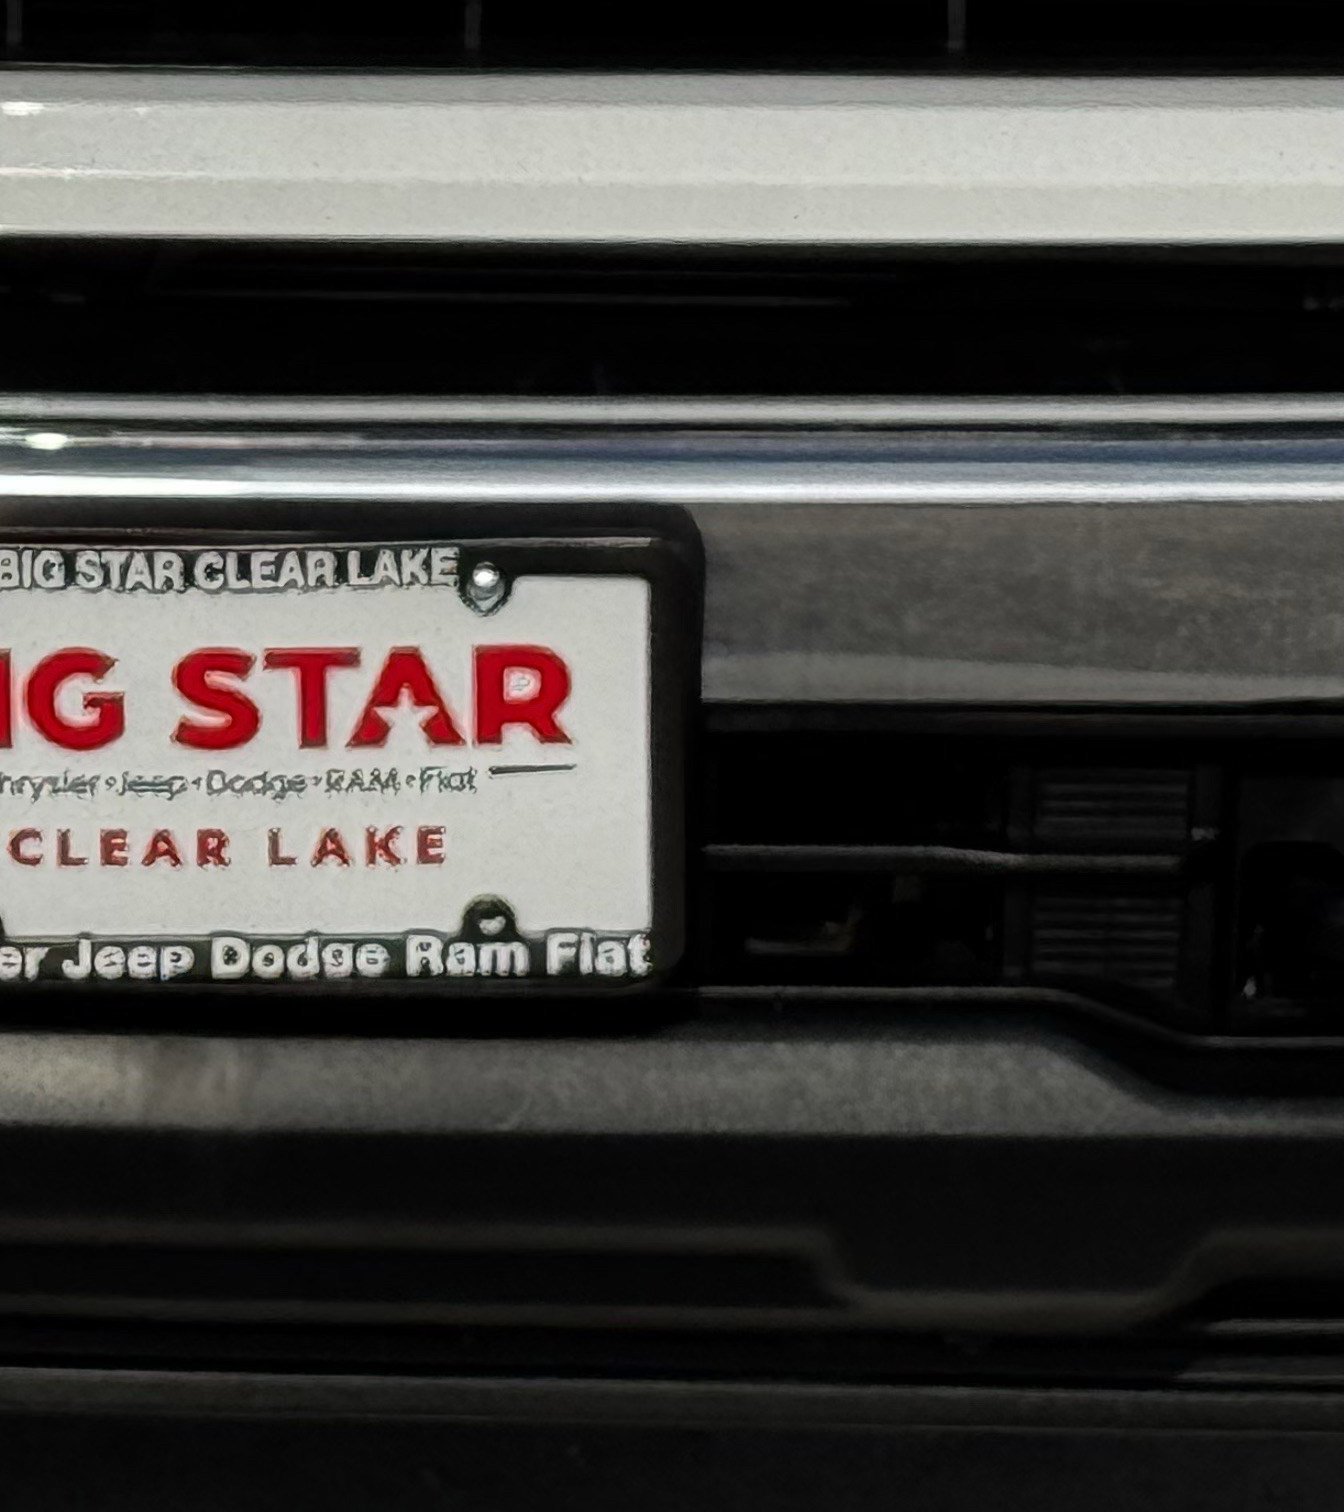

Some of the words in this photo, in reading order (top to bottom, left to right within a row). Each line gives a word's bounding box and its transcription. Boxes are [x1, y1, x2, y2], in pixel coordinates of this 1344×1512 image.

[74, 549, 185, 589] STAR
[194, 549, 336, 589] CLEAR
[346, 547, 461, 586] LAKE
[169, 644, 574, 752] STAR
[8, 827, 232, 869] CLEAR
[267, 825, 448, 866] LAKE
[61, 938, 195, 982] Jeep
[212, 936, 390, 978] Dodge
[406, 934, 531, 978] Ram
